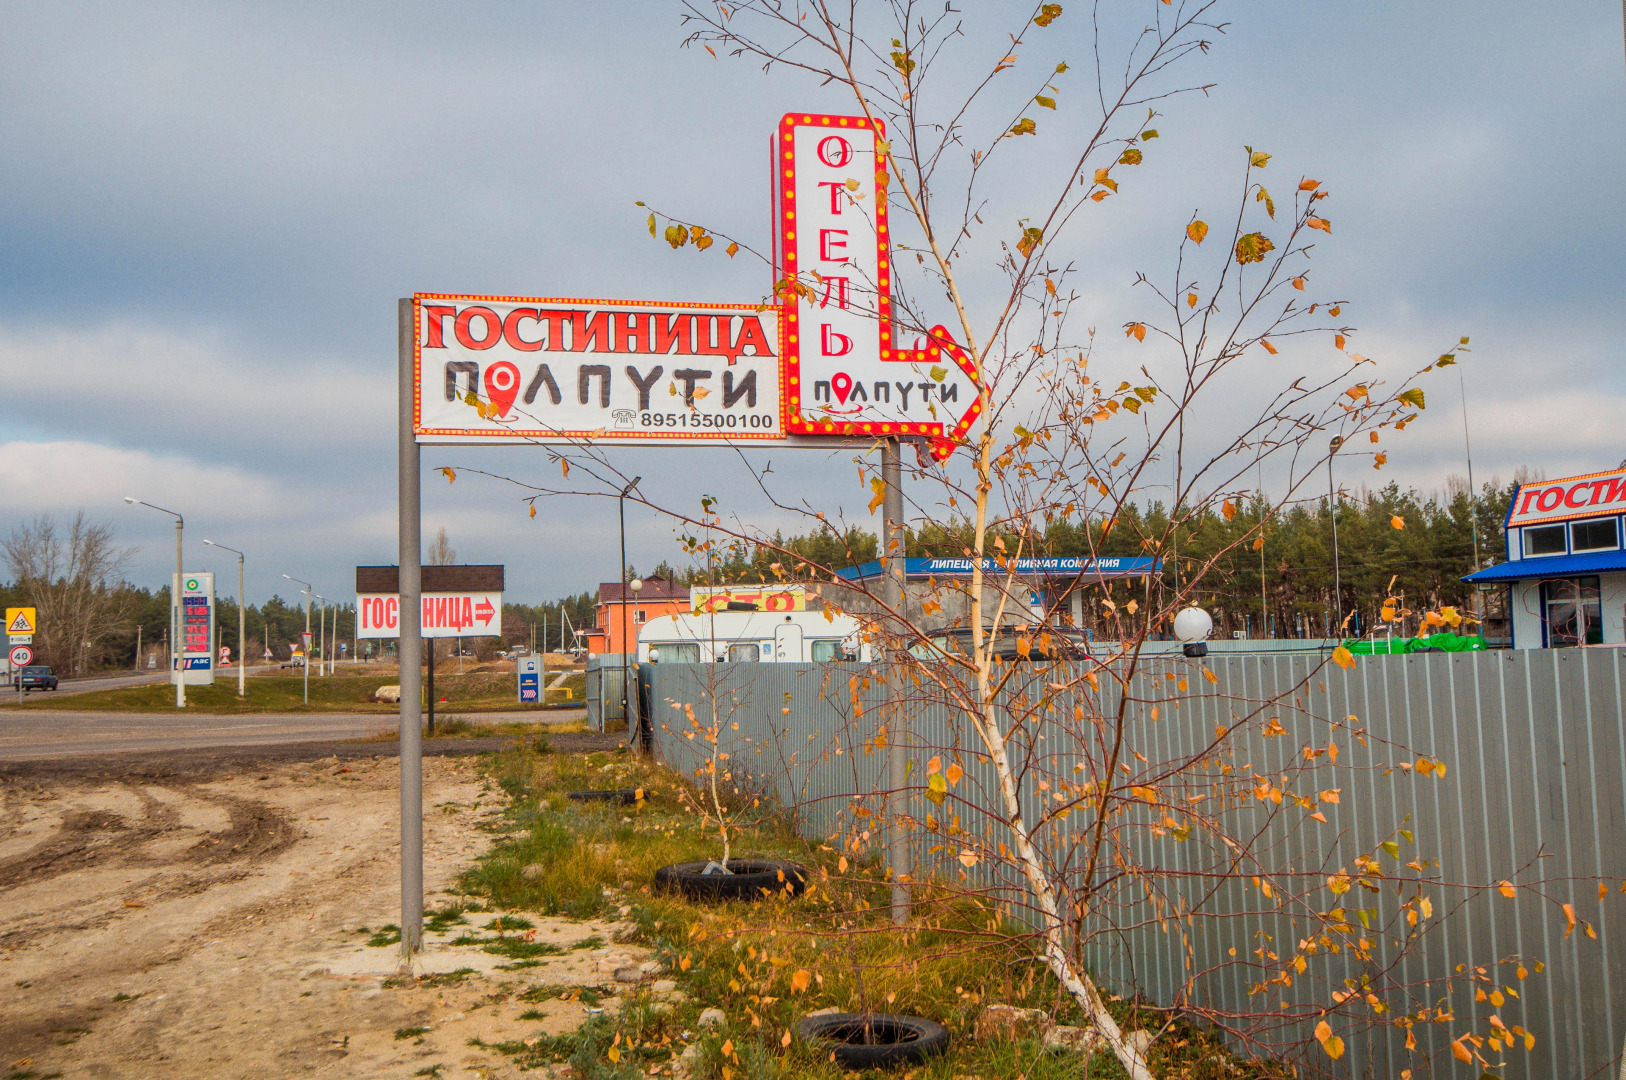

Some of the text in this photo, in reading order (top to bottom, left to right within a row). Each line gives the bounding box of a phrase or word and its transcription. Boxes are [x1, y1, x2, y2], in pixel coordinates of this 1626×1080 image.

[816, 135, 854, 357] ОТЕЛЬ
[423, 304, 779, 367] ГОСТИНИЦА
[640, 412, 774, 428] 89515500100
[362, 597, 474, 632] ГОСНИЦА
[14, 652, 28, 661] 40
